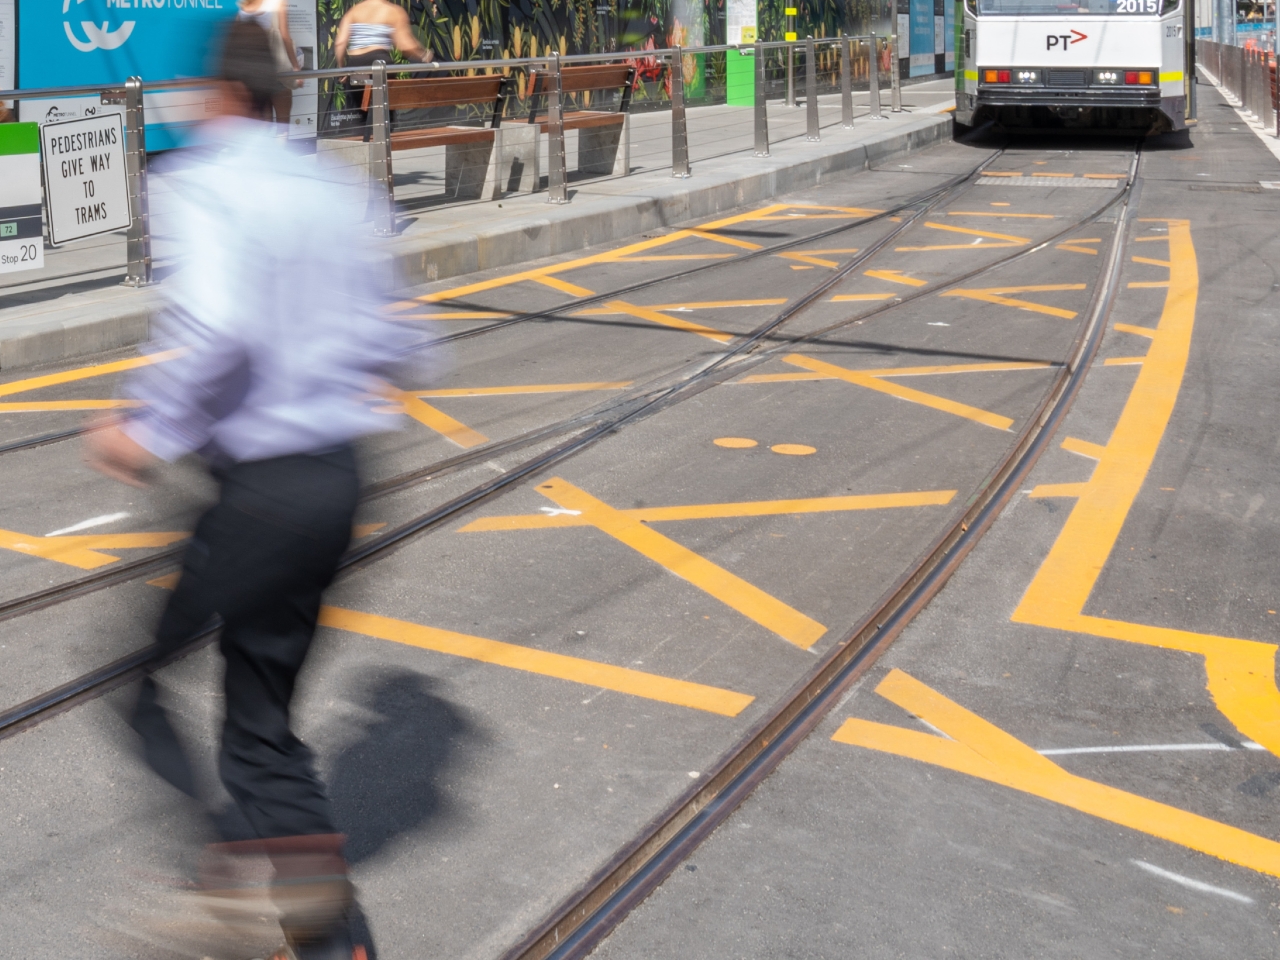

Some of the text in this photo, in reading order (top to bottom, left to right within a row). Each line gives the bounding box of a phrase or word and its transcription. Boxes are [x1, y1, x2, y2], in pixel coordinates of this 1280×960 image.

[51, 127, 118, 155] PEDESTRIANS
[61, 152, 111, 178] GIVE WAY
[83, 181, 95, 199] TO
[75, 202, 107, 225] TRAMS
[5, 226, 13, 234] 72
[2, 244, 37, 265] Stop 20
